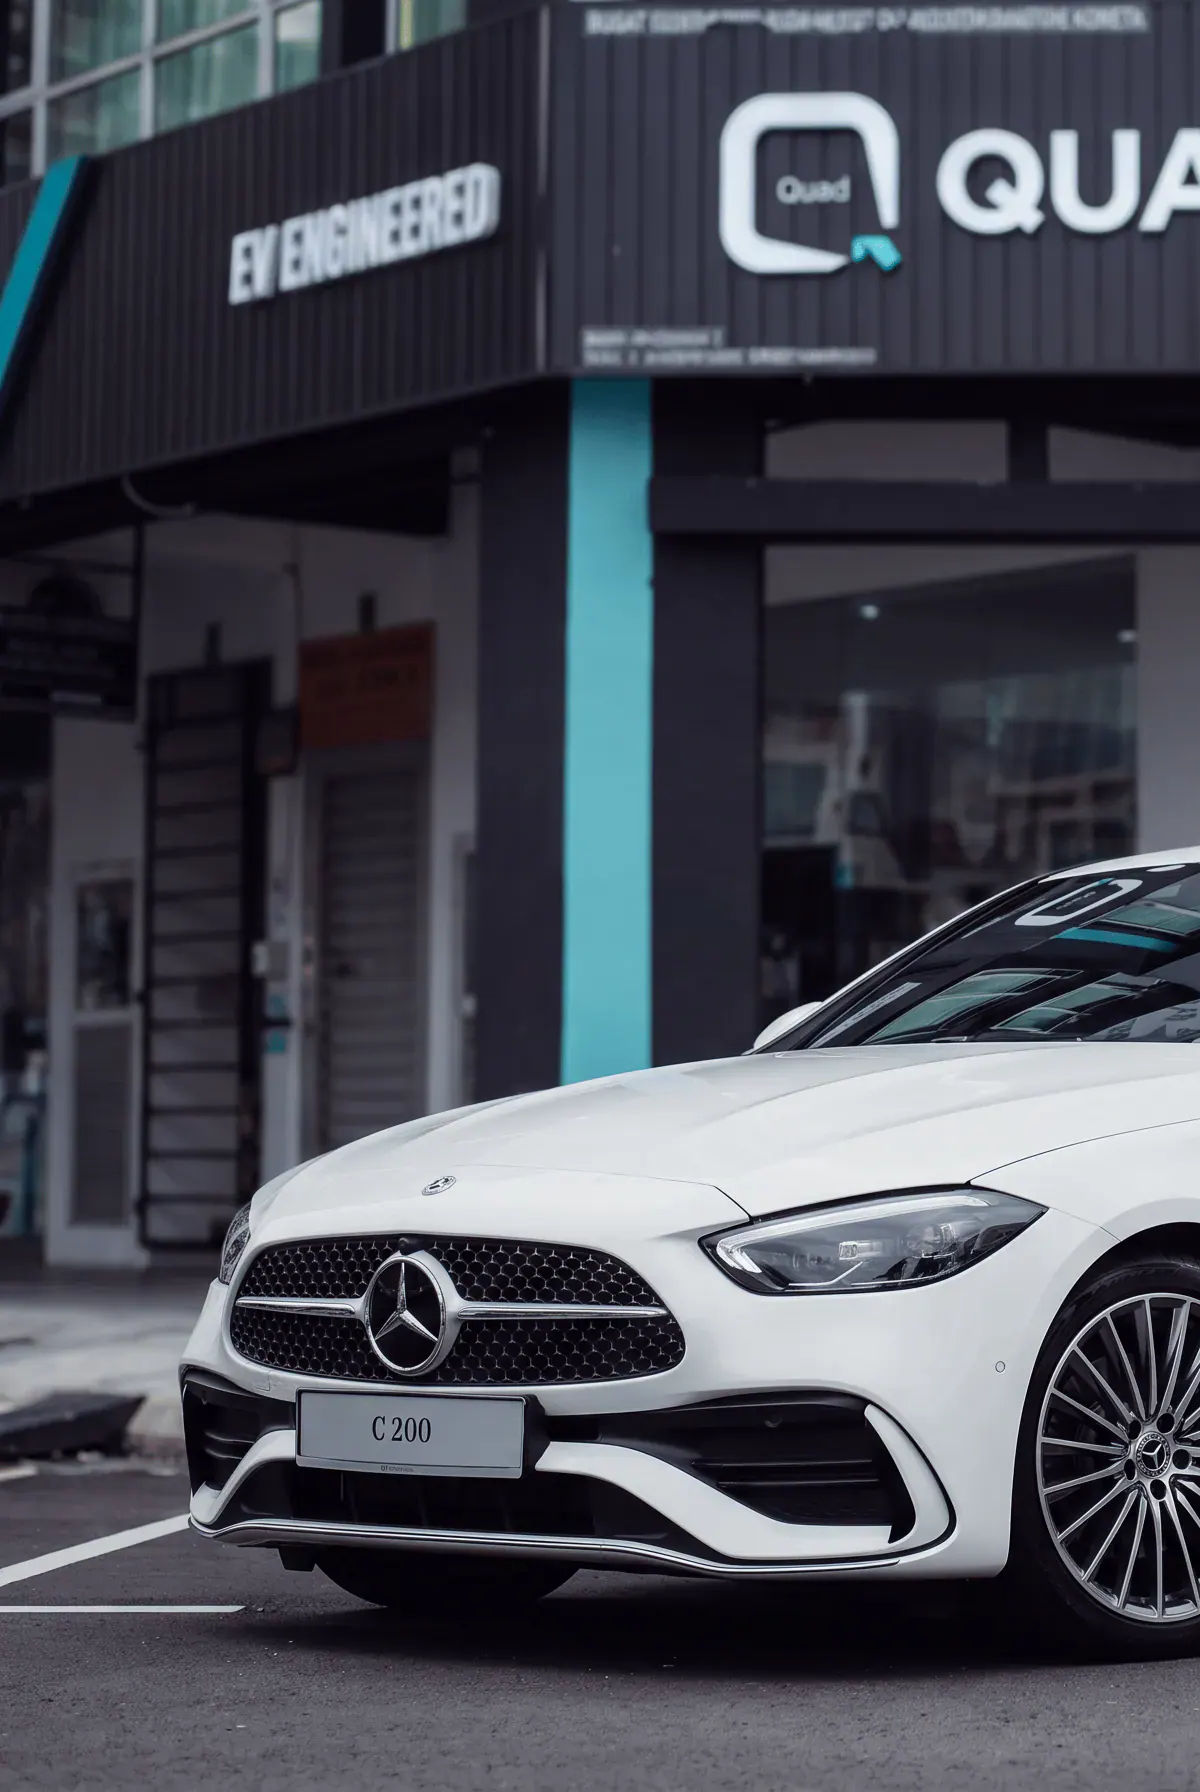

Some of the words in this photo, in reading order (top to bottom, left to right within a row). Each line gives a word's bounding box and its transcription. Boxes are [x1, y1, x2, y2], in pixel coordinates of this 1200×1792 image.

[776, 174, 850, 205] Quad
[228, 223, 280, 305] EV
[279, 162, 500, 291] ENGINEERED
[372, 1415, 386, 1441] C
[391, 1416, 431, 1443] 200
